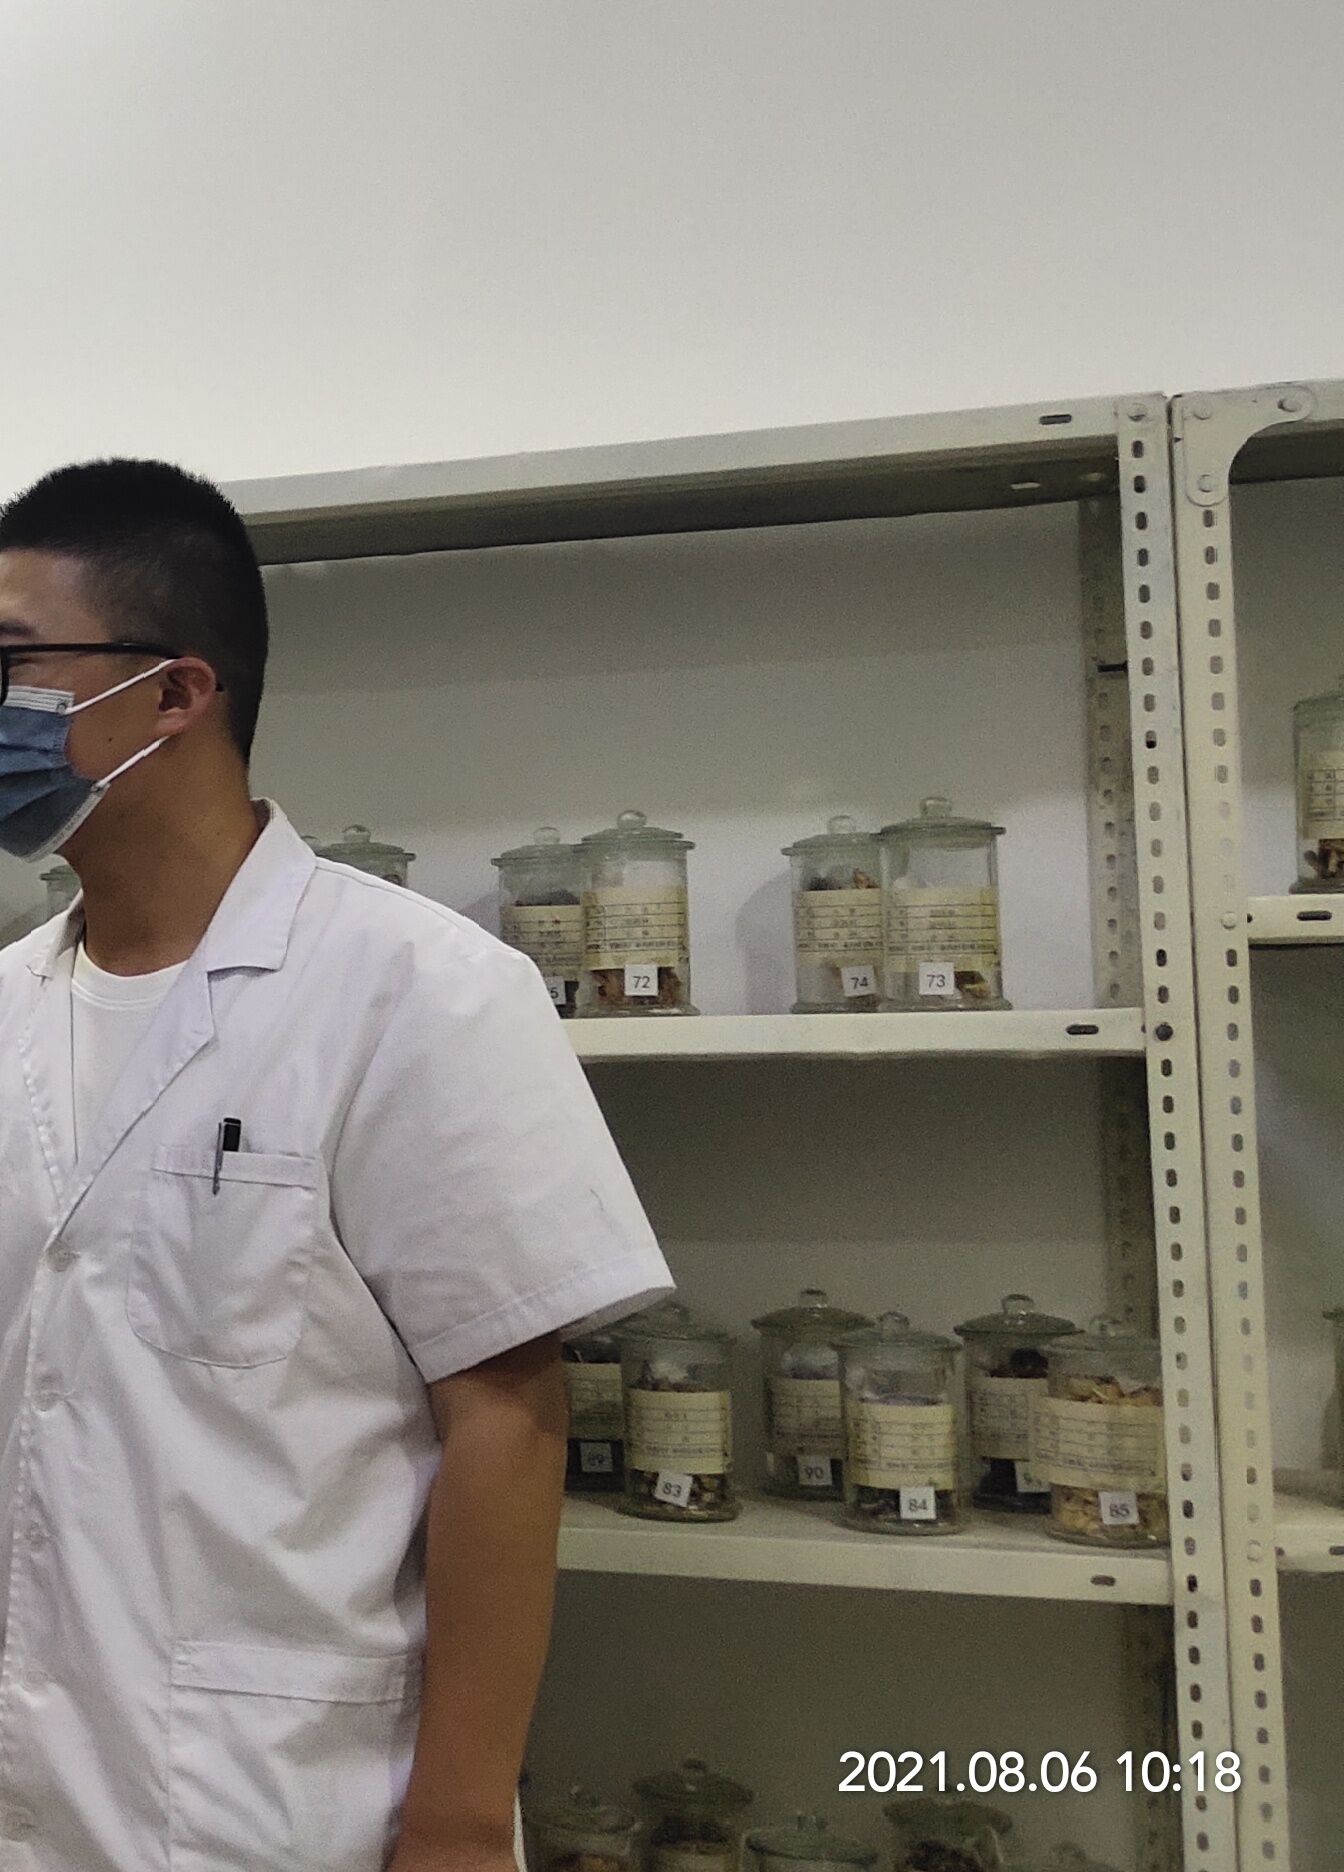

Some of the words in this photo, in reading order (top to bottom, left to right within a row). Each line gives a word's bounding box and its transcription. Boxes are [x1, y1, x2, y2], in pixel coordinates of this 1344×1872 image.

[632, 976, 650, 989] 72
[850, 977, 869, 989] 74
[926, 974, 946, 988] 73
[804, 1466, 824, 1479] 90
[662, 1482, 683, 1498] 83
[907, 1498, 928, 1513] 84
[1108, 1503, 1130, 1518] 85
